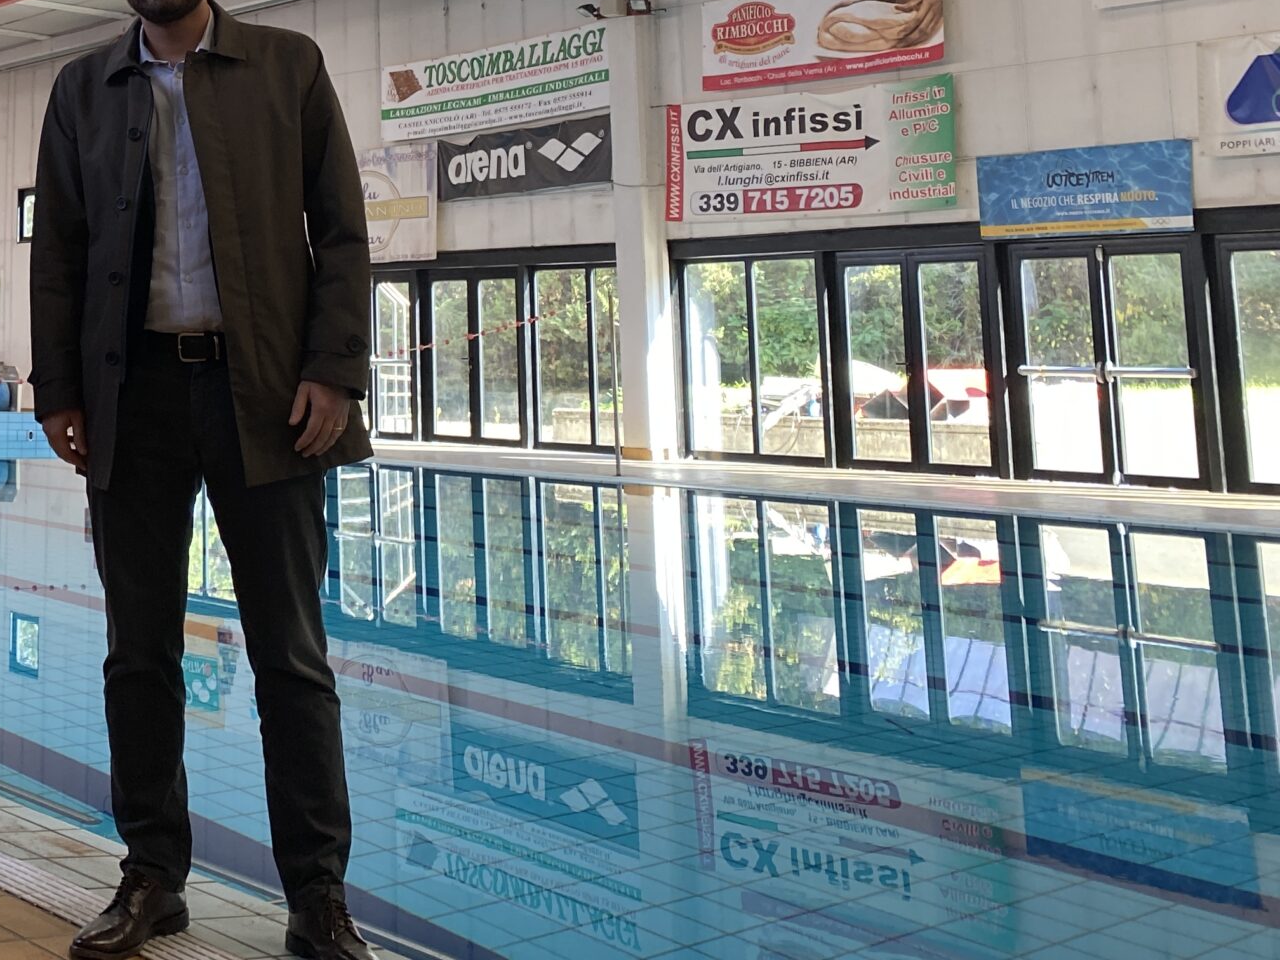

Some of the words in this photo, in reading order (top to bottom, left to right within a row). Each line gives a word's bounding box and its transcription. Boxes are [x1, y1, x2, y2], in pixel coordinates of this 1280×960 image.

[732, 5, 771, 22] PANIFICIO
[716, 19, 788, 40] RIMBOCCHI
[424, 28, 606, 88] TOSCOIMBALLAGGI
[759, 55, 770, 66] del
[492, 77, 504, 85] PER
[505, 67, 552, 82] TRATTAMENTO
[390, 104, 441, 118] LAVORAZIONI
[442, 98, 482, 110] LEGNAMI
[488, 87, 542, 103] IMBALLAGGI
[545, 71, 606, 90] INDUSTRIALI
[538, 99, 551, 107] Fax
[892, 87, 929, 105] Infissi
[933, 86, 945, 98] in
[889, 103, 950, 121] Alluminio
[687, 106, 744, 142] CX
[752, 104, 862, 138] infissi
[901, 127, 909, 136] e
[913, 120, 939, 134] PVC
[1220, 140, 1251, 149] POPPI
[1254, 137, 1276, 147] (AR)
[448, 144, 526, 185] arena
[669, 110, 682, 218] WWW.CXINFISSI.IT
[693, 164, 705, 174] Via
[773, 160, 782, 168] 15
[790, 157, 833, 168] BIBBIENA
[836, 156, 858, 166] (AR)
[895, 152, 952, 167] Chiusure
[899, 168, 933, 182] Civili
[937, 170, 945, 179] e
[699, 192, 739, 212] 339
[748, 189, 789, 211] 715
[796, 186, 854, 209] 7205
[889, 182, 956, 200] industriali
[1011, 198, 1019, 209] IL
[1021, 196, 1057, 208] NEGOZIO
[1058, 195, 1074, 206] CHE
[1077, 192, 1119, 205] RESPIRA
[369, 236, 384, 245] ar
